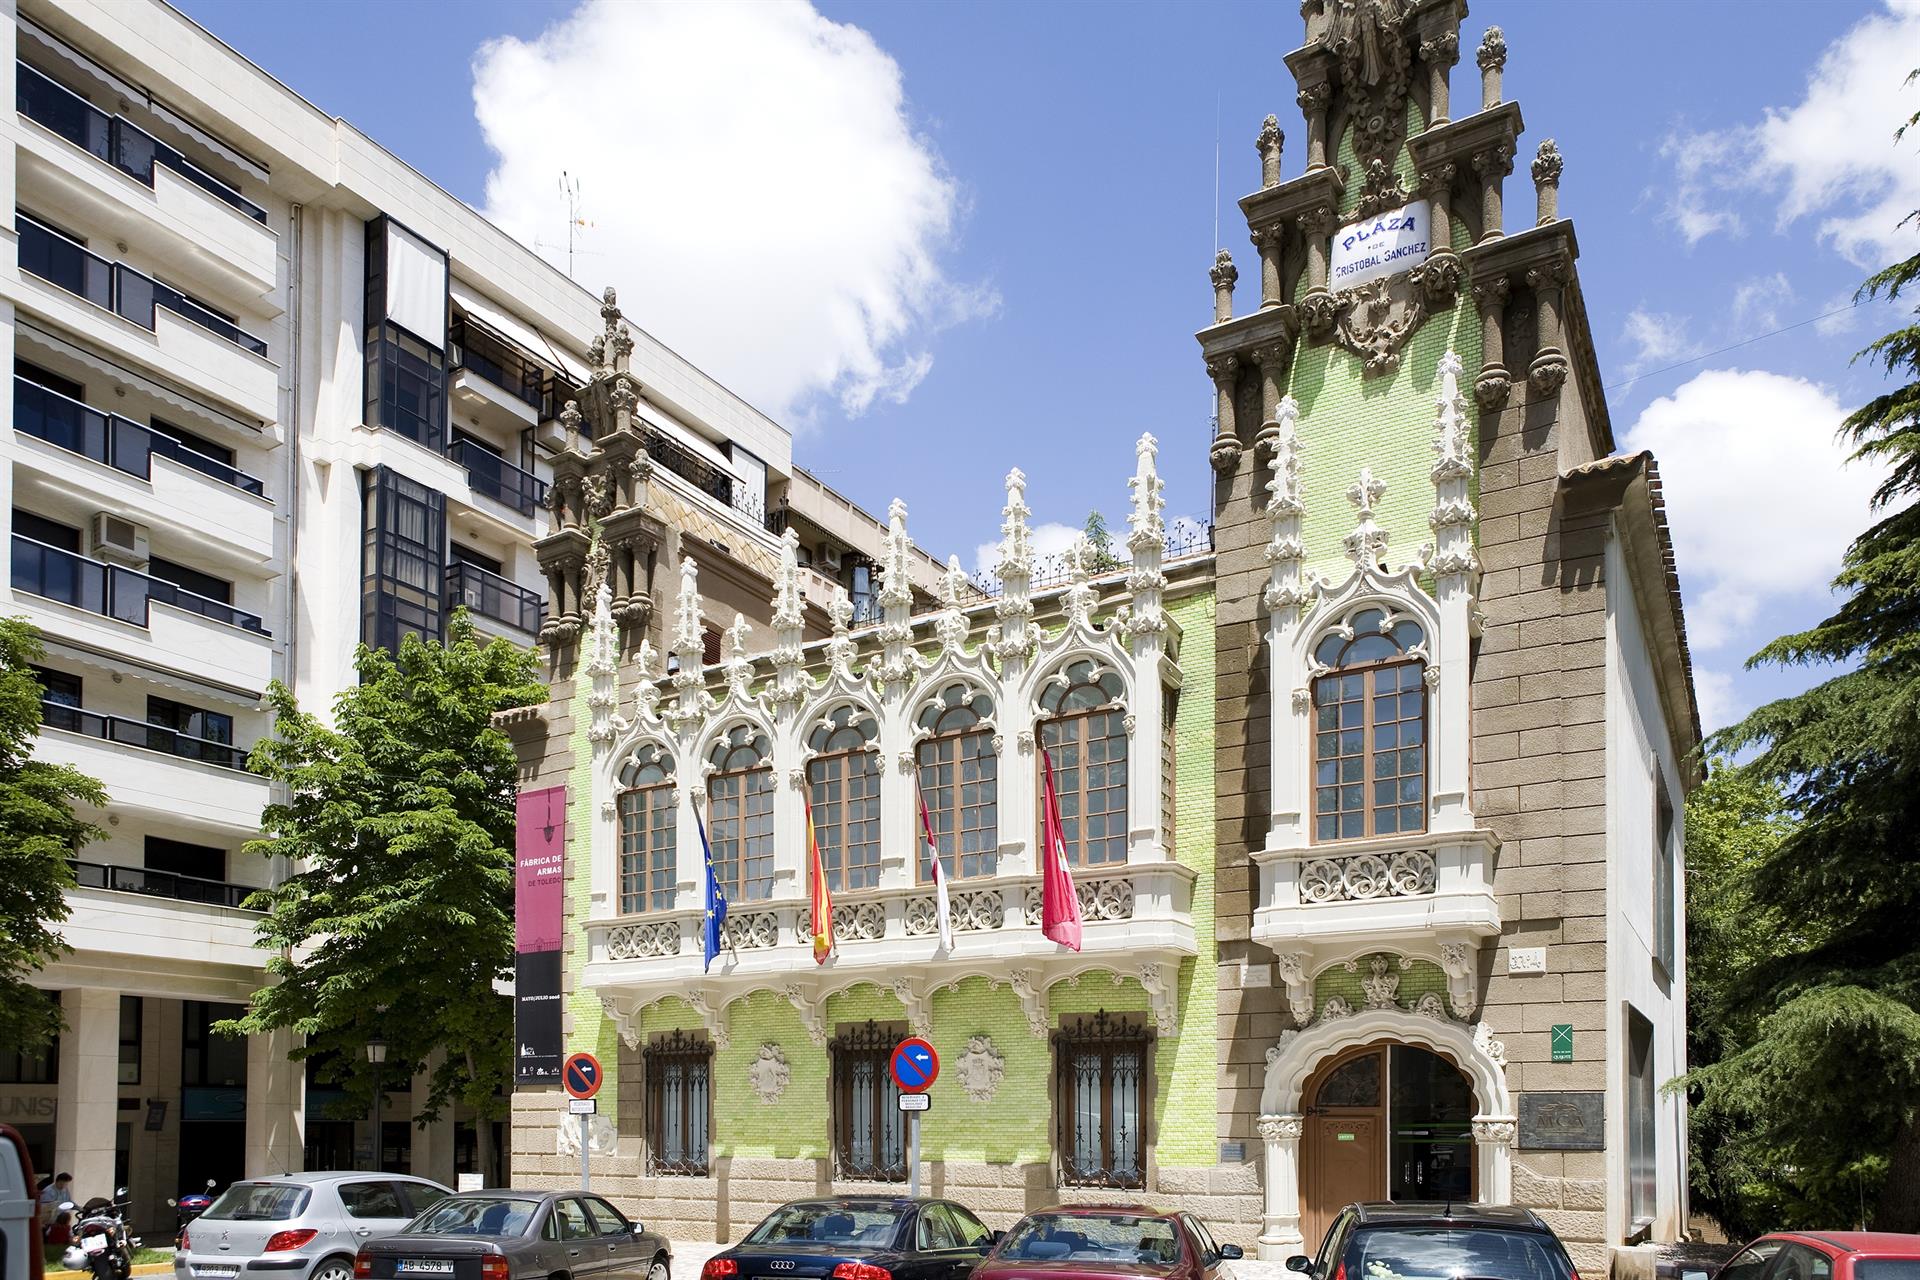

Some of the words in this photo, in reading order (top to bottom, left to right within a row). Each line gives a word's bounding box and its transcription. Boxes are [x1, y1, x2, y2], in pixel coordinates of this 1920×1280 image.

[1343, 217, 1415, 251] PLAZA
[1336, 256, 1381, 278] CRISTOBAL
[1385, 242, 1426, 261] SANCHEZ
[552, 855, 562, 863] DE
[537, 866, 562, 876] ARMAS
[537, 877, 561, 886] TOLEDO
[404, 1260, 414, 1271] AB
[420, 1260, 442, 1271] 4578
